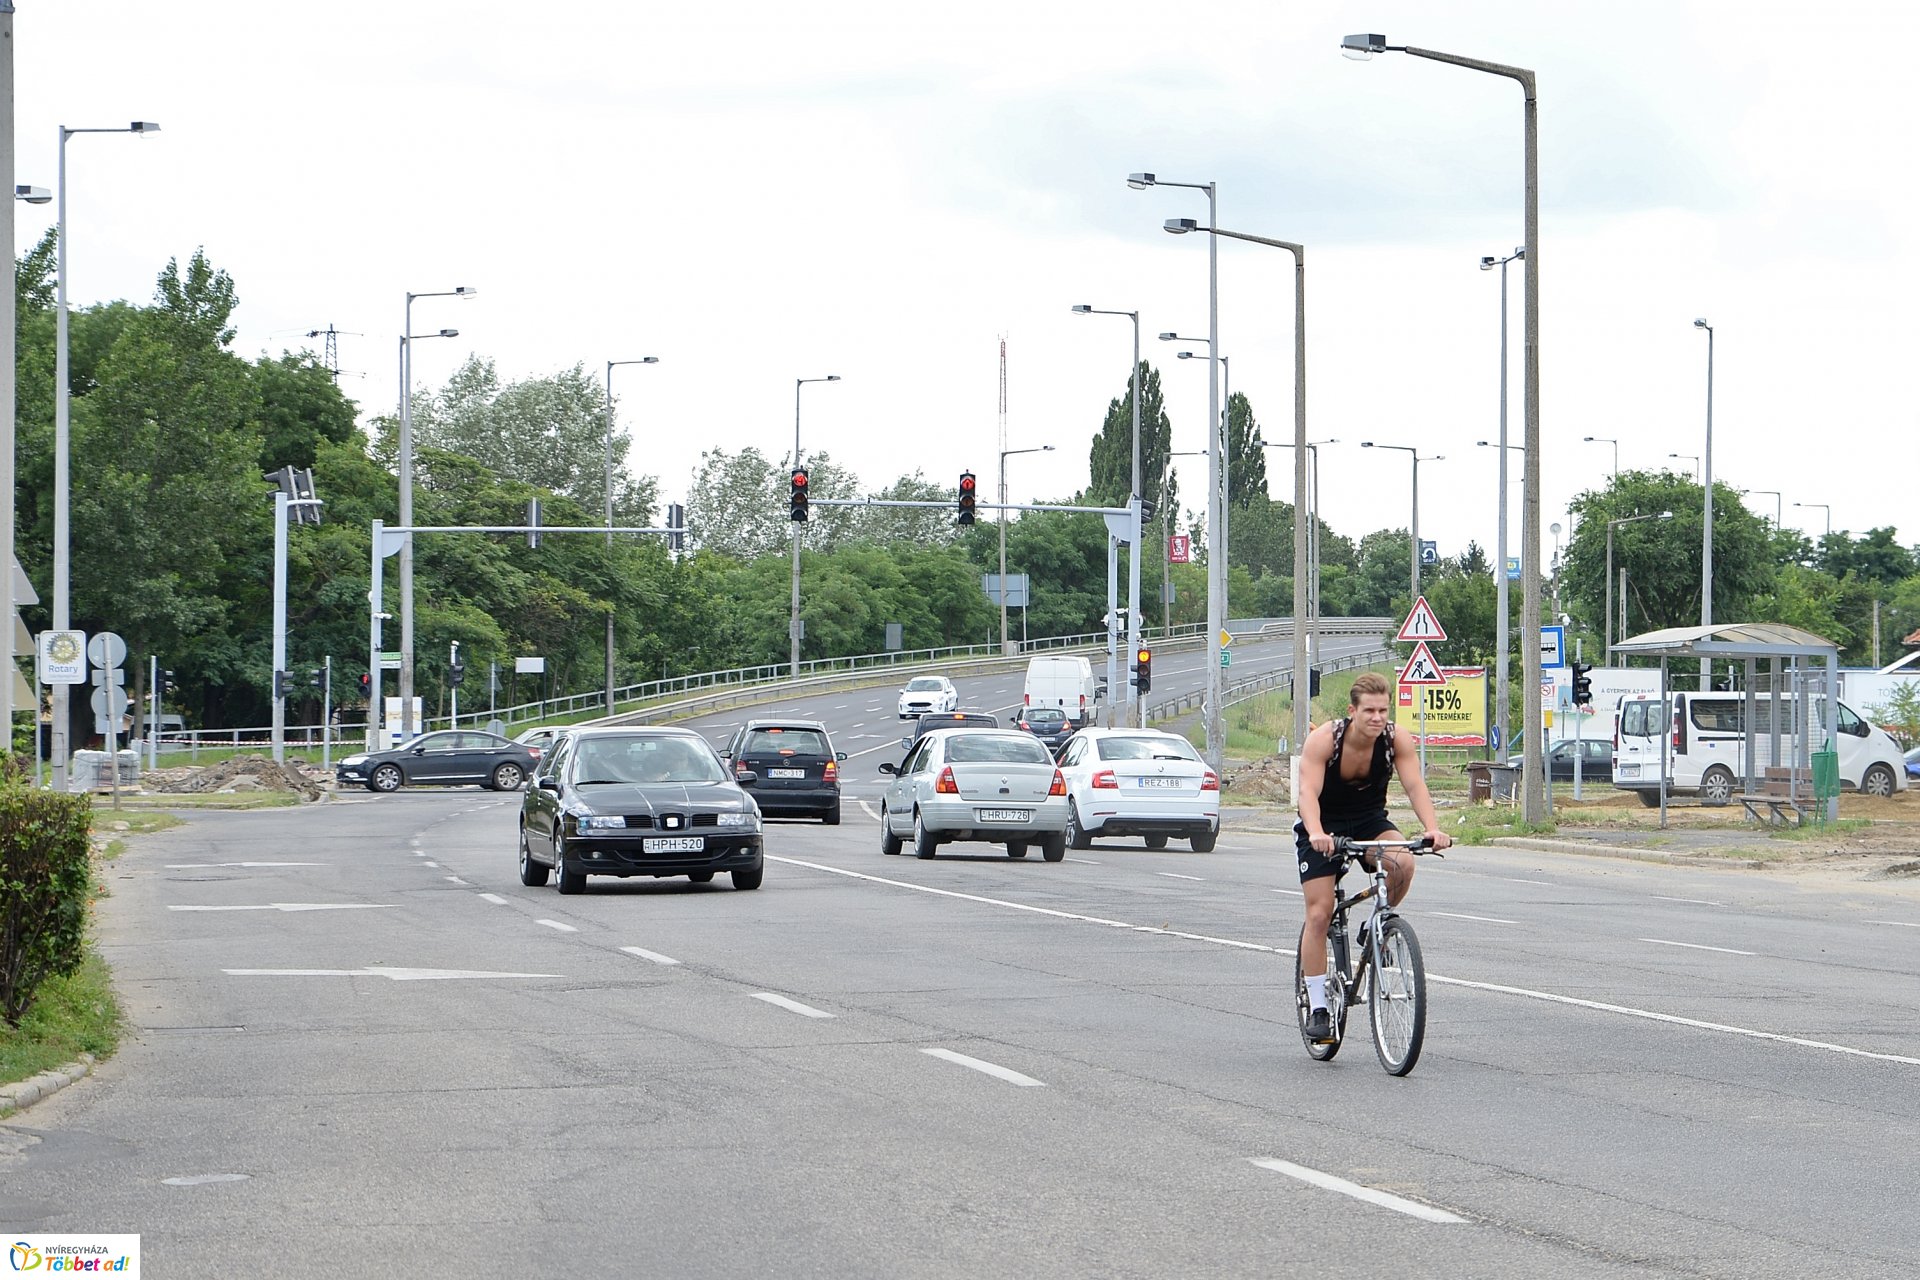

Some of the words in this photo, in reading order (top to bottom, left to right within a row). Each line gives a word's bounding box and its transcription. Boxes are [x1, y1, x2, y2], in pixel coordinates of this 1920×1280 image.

[48, 664, 79, 674] Rotary
[1424, 689, 1461, 710] -15%
[1437, 710, 1472, 721] TERMÉKRE!
[1144, 779, 1180, 787] REZ-188
[988, 810, 1028, 820] HRU-726
[652, 838, 703, 850] HPH-520
